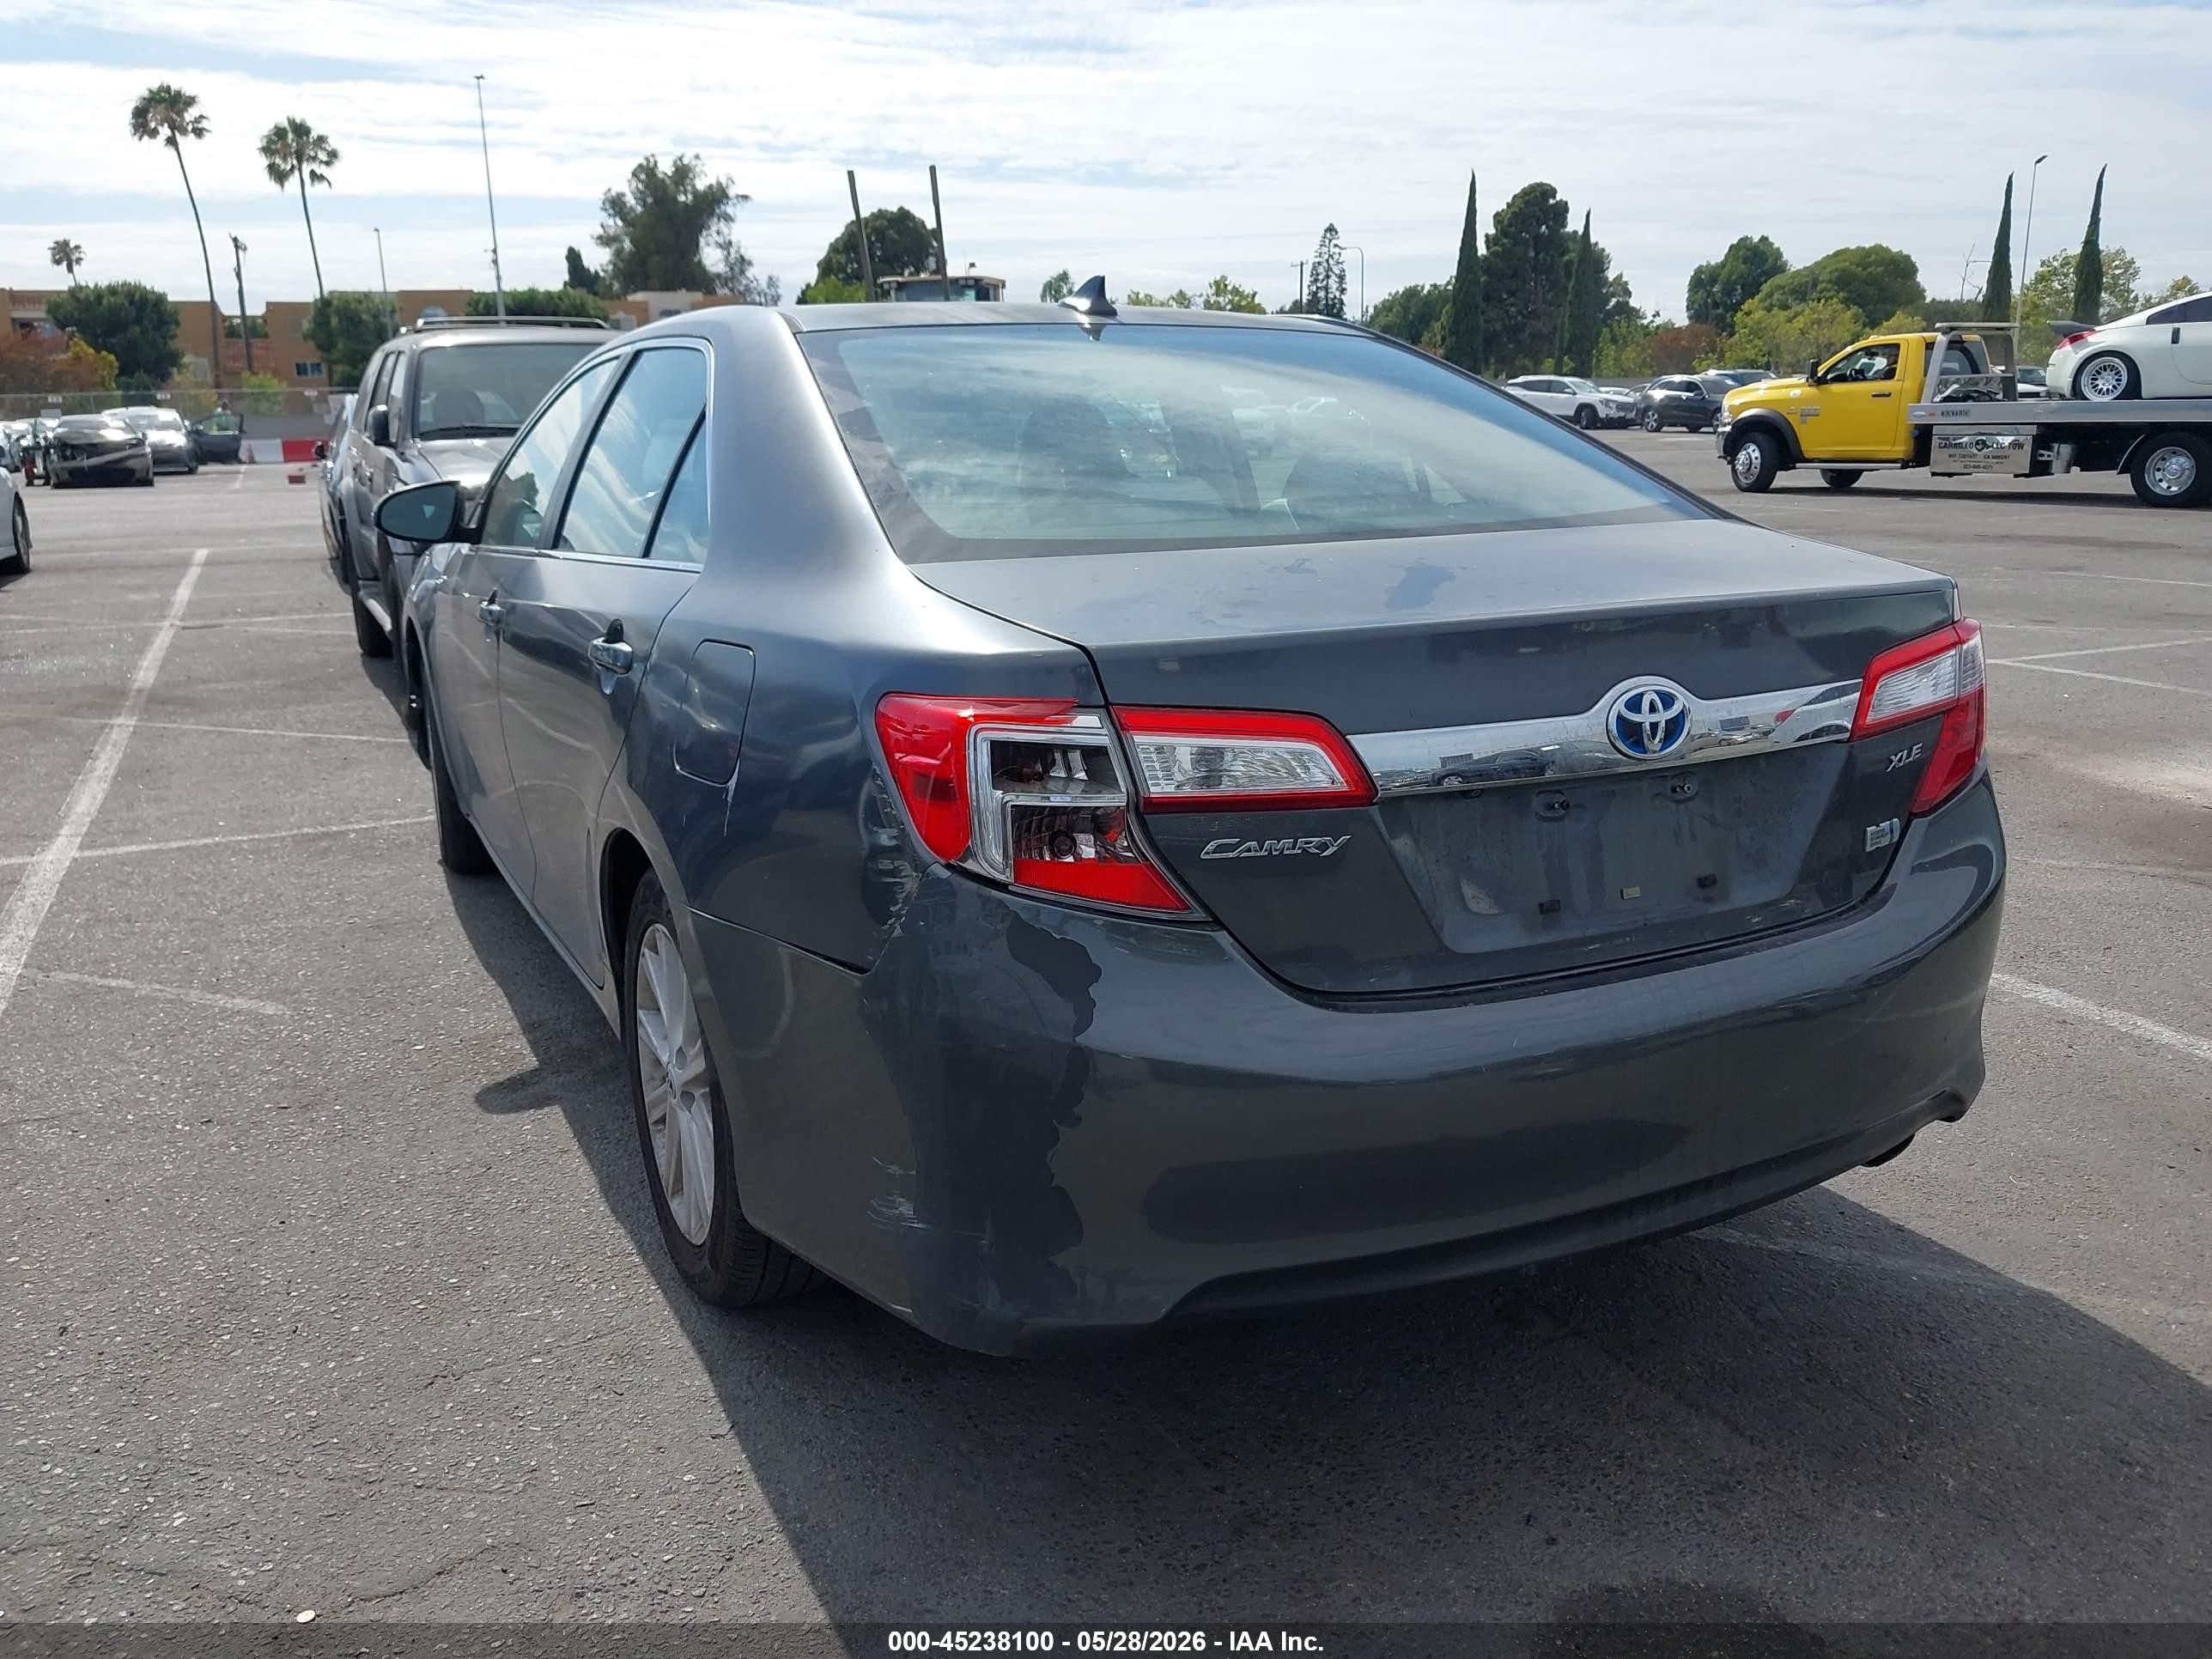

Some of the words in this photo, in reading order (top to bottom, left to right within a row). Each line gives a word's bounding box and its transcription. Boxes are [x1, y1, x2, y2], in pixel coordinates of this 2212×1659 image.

[1938, 441, 1974, 450] CARRILLO
[1991, 441, 2005, 450] LLC
[2008, 441, 2026, 451] TOW
[1885, 742, 1923, 773] XLE
[1200, 835, 1353, 860] CAMRY
